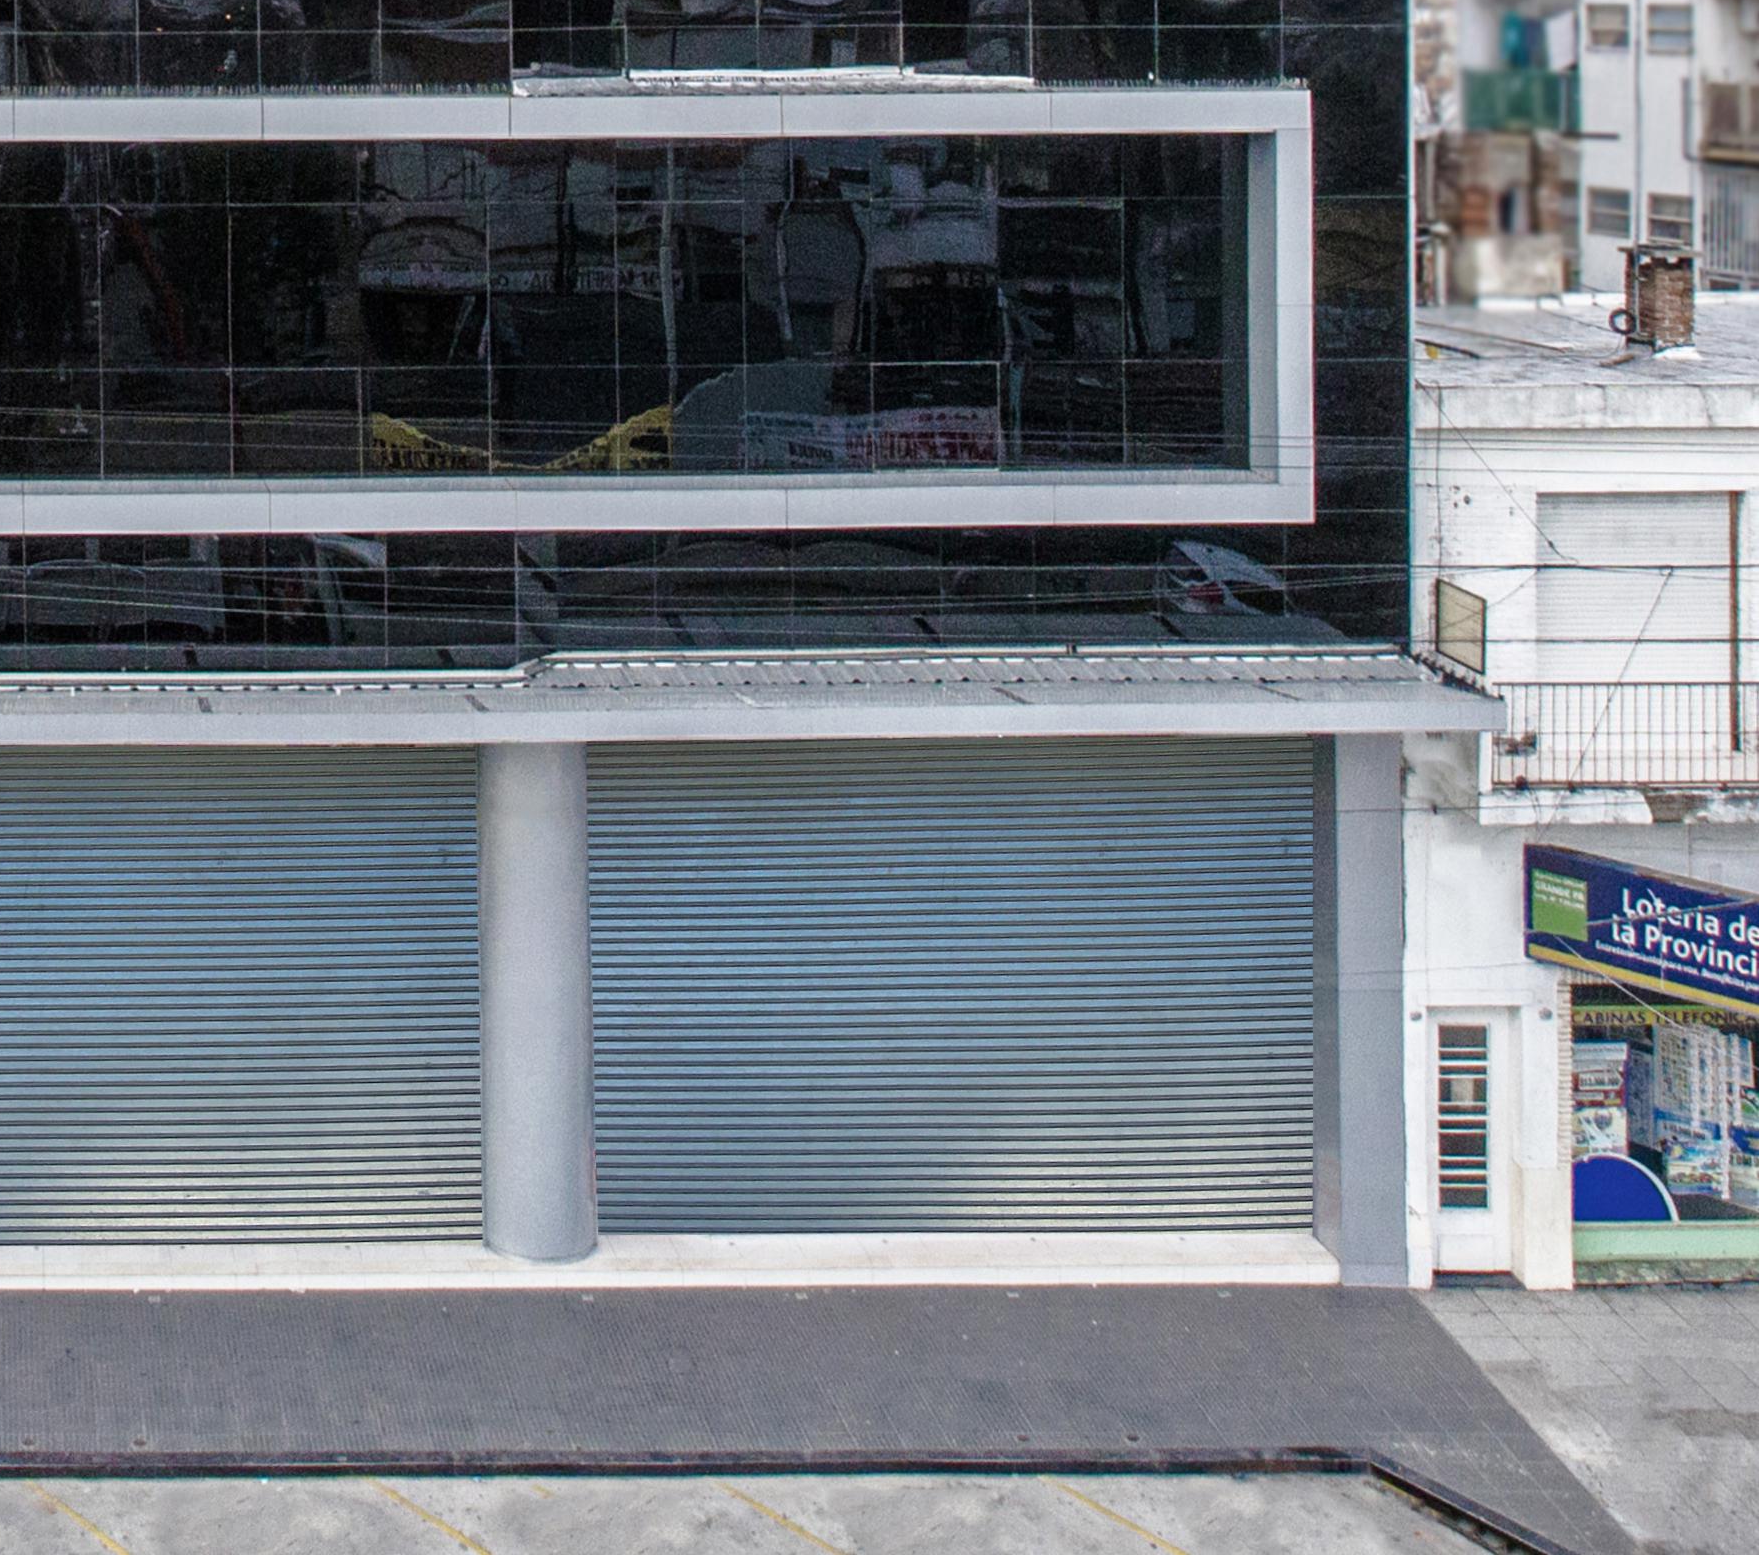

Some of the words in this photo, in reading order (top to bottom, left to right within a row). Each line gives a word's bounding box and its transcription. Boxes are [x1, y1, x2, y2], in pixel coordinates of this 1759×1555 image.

[1611, 913, 1636, 946] la
[1728, 915, 1759, 946] de
[1572, 1011, 1645, 1025] CABINAS
